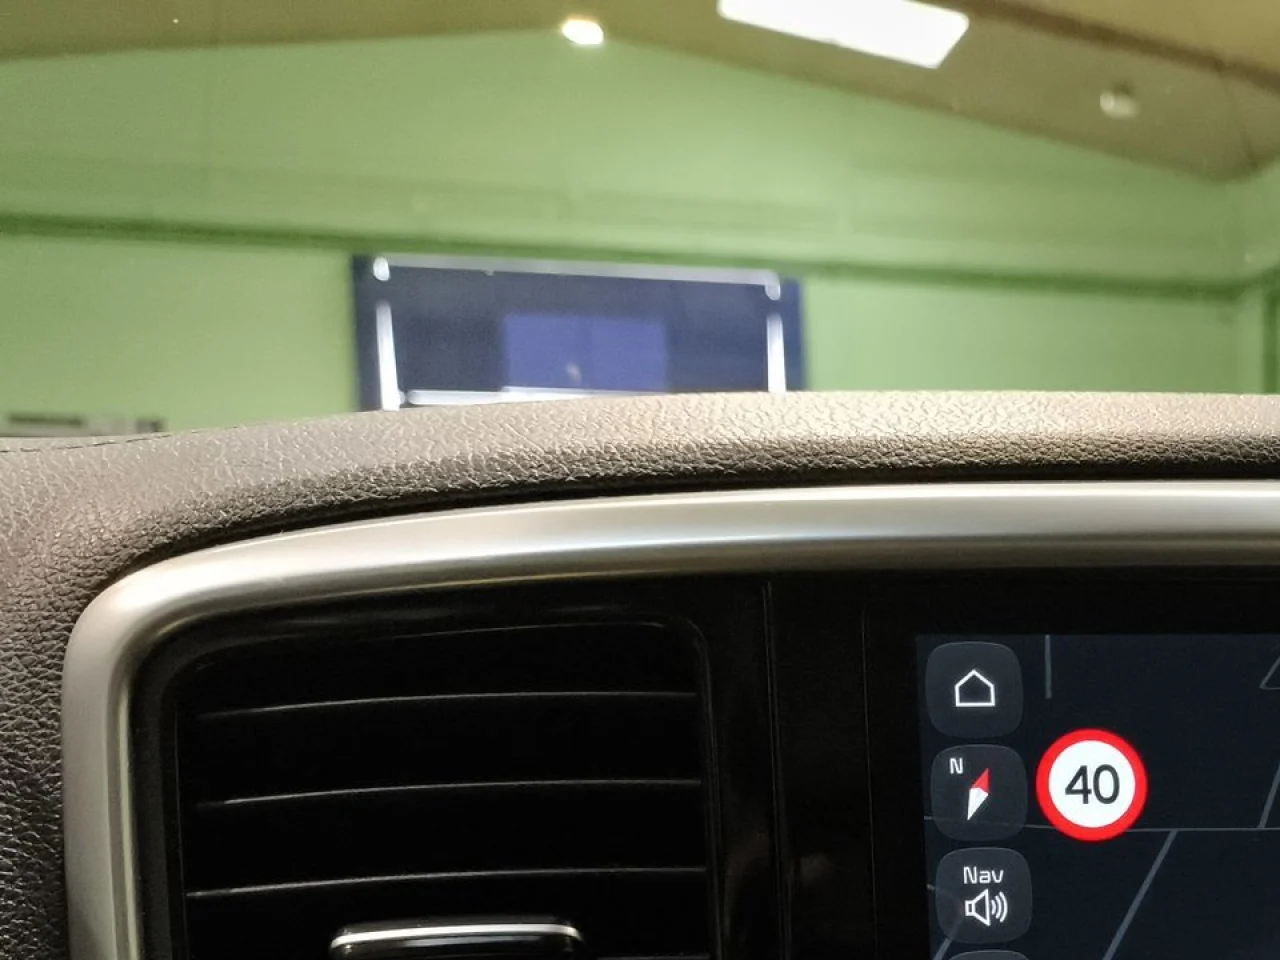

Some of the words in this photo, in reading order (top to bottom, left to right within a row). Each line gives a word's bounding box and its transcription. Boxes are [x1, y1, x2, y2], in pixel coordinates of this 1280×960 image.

[949, 757, 964, 775] N
[1064, 764, 1121, 805] 40
[963, 865, 1004, 885] Nav
